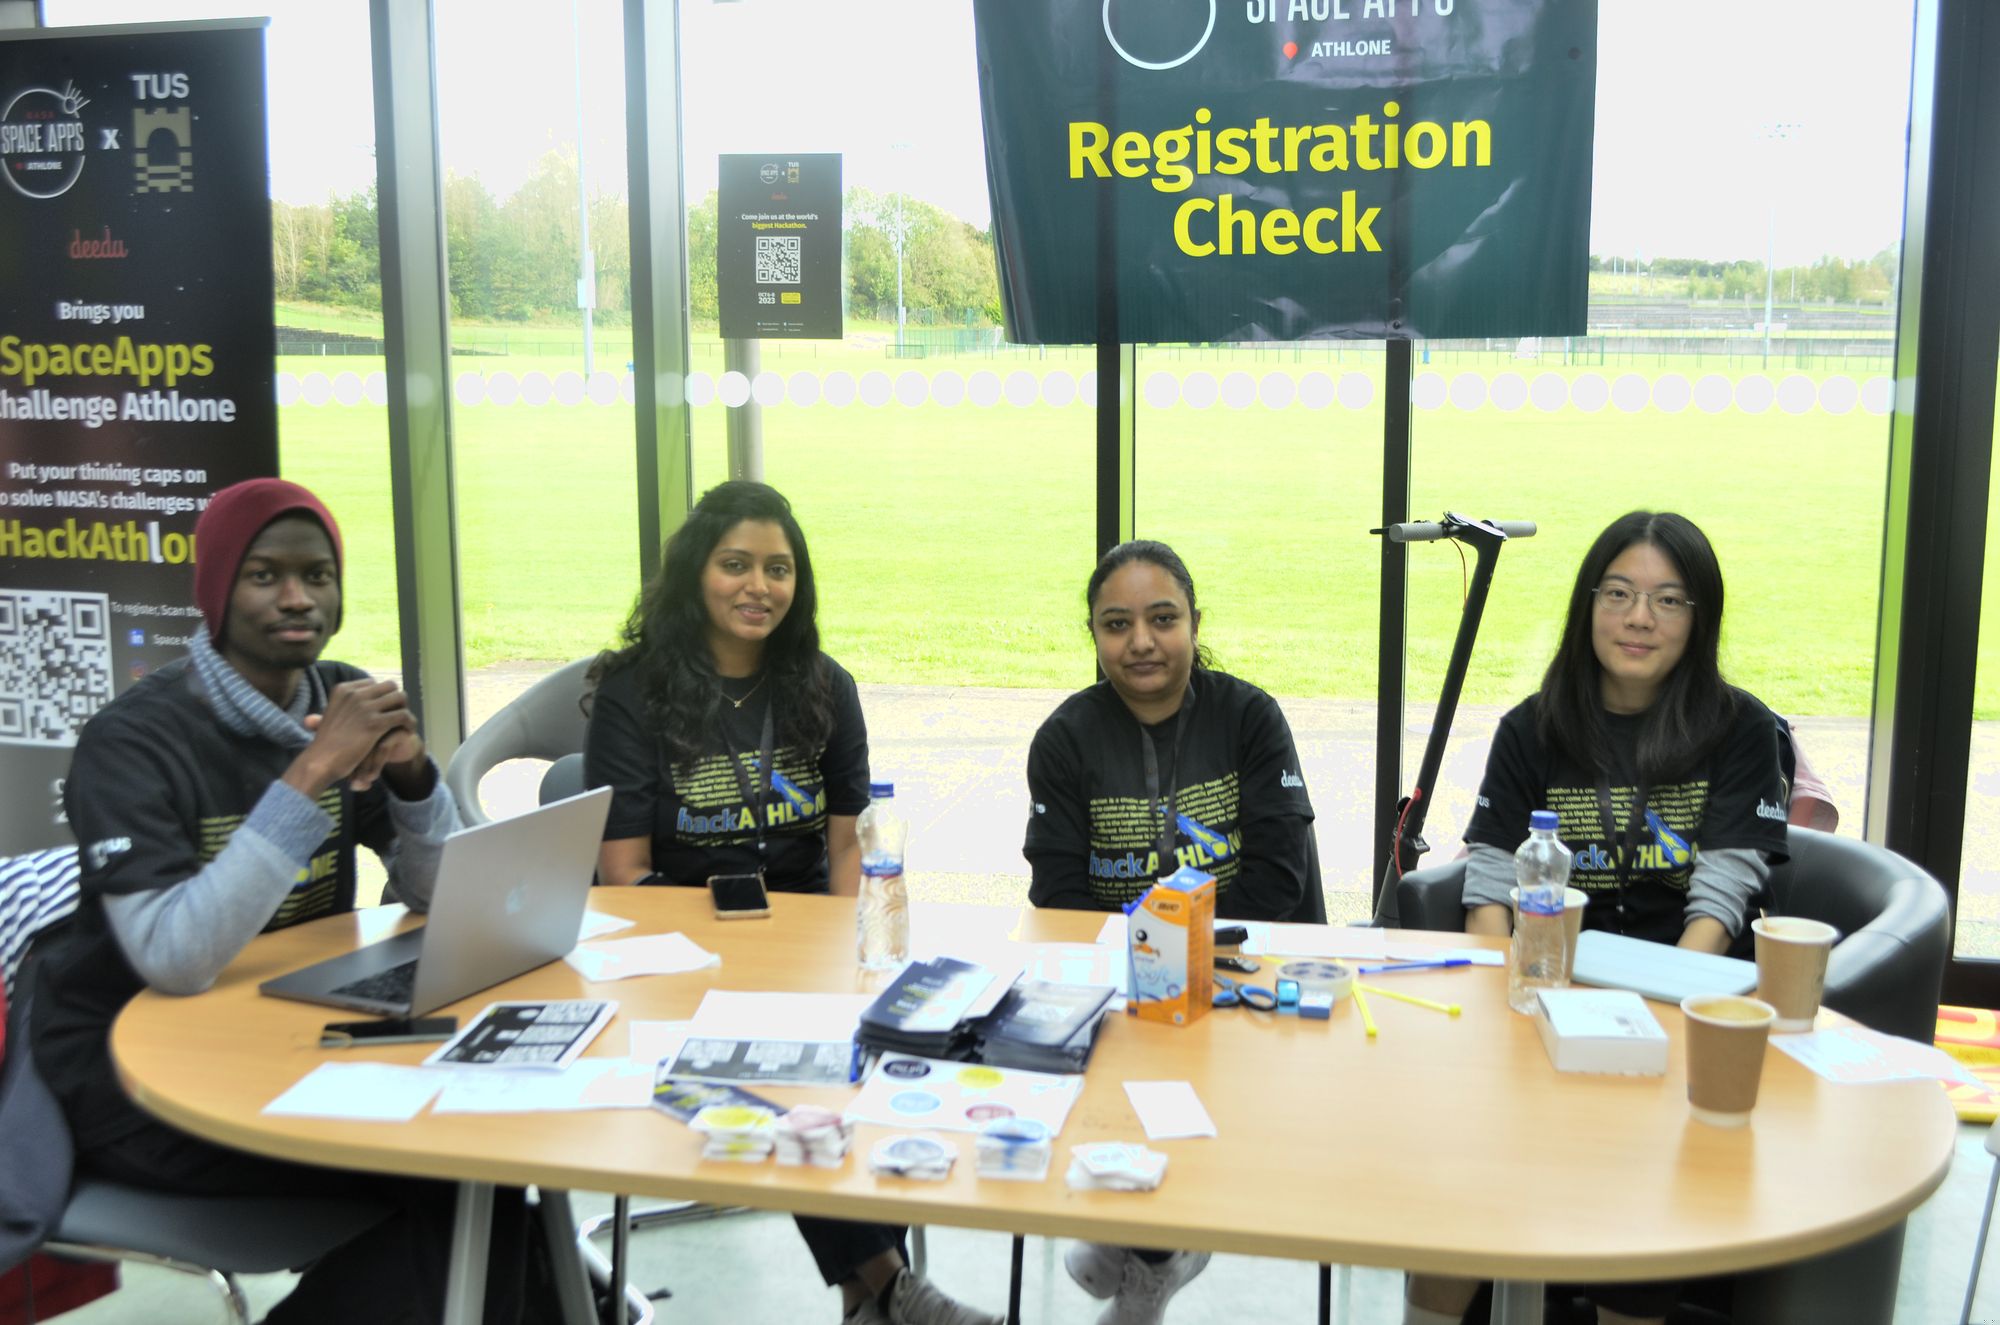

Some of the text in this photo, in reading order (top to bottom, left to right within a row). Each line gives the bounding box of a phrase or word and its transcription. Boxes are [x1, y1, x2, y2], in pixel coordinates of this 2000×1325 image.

[1311, 39, 1391, 58] ATHLONE
[132, 73, 190, 100] TUS
[2, 121, 85, 154] SPACE APPS
[1068, 102, 1491, 193] Registration
[27, 160, 62, 171] ATHLONE
[752, 222, 774, 231] biggest
[758, 213, 770, 222] join
[1173, 190, 1382, 257] Check
[69, 226, 128, 259] deedu
[58, 300, 145, 325] Brings you
[0, 335, 214, 387] SpaceApps
[0, 388, 237, 428] hallenge Athlone
[9, 462, 207, 487] Put your thinking caps on
[0, 494, 9, 506] o
[11, 489, 53, 507] solve
[55, 490, 109, 508] NASA's
[110, 491, 195, 515] challenges
[110, 601, 122, 613] To
[160, 605, 185, 616] Scan
[153, 633, 180, 646] Space
